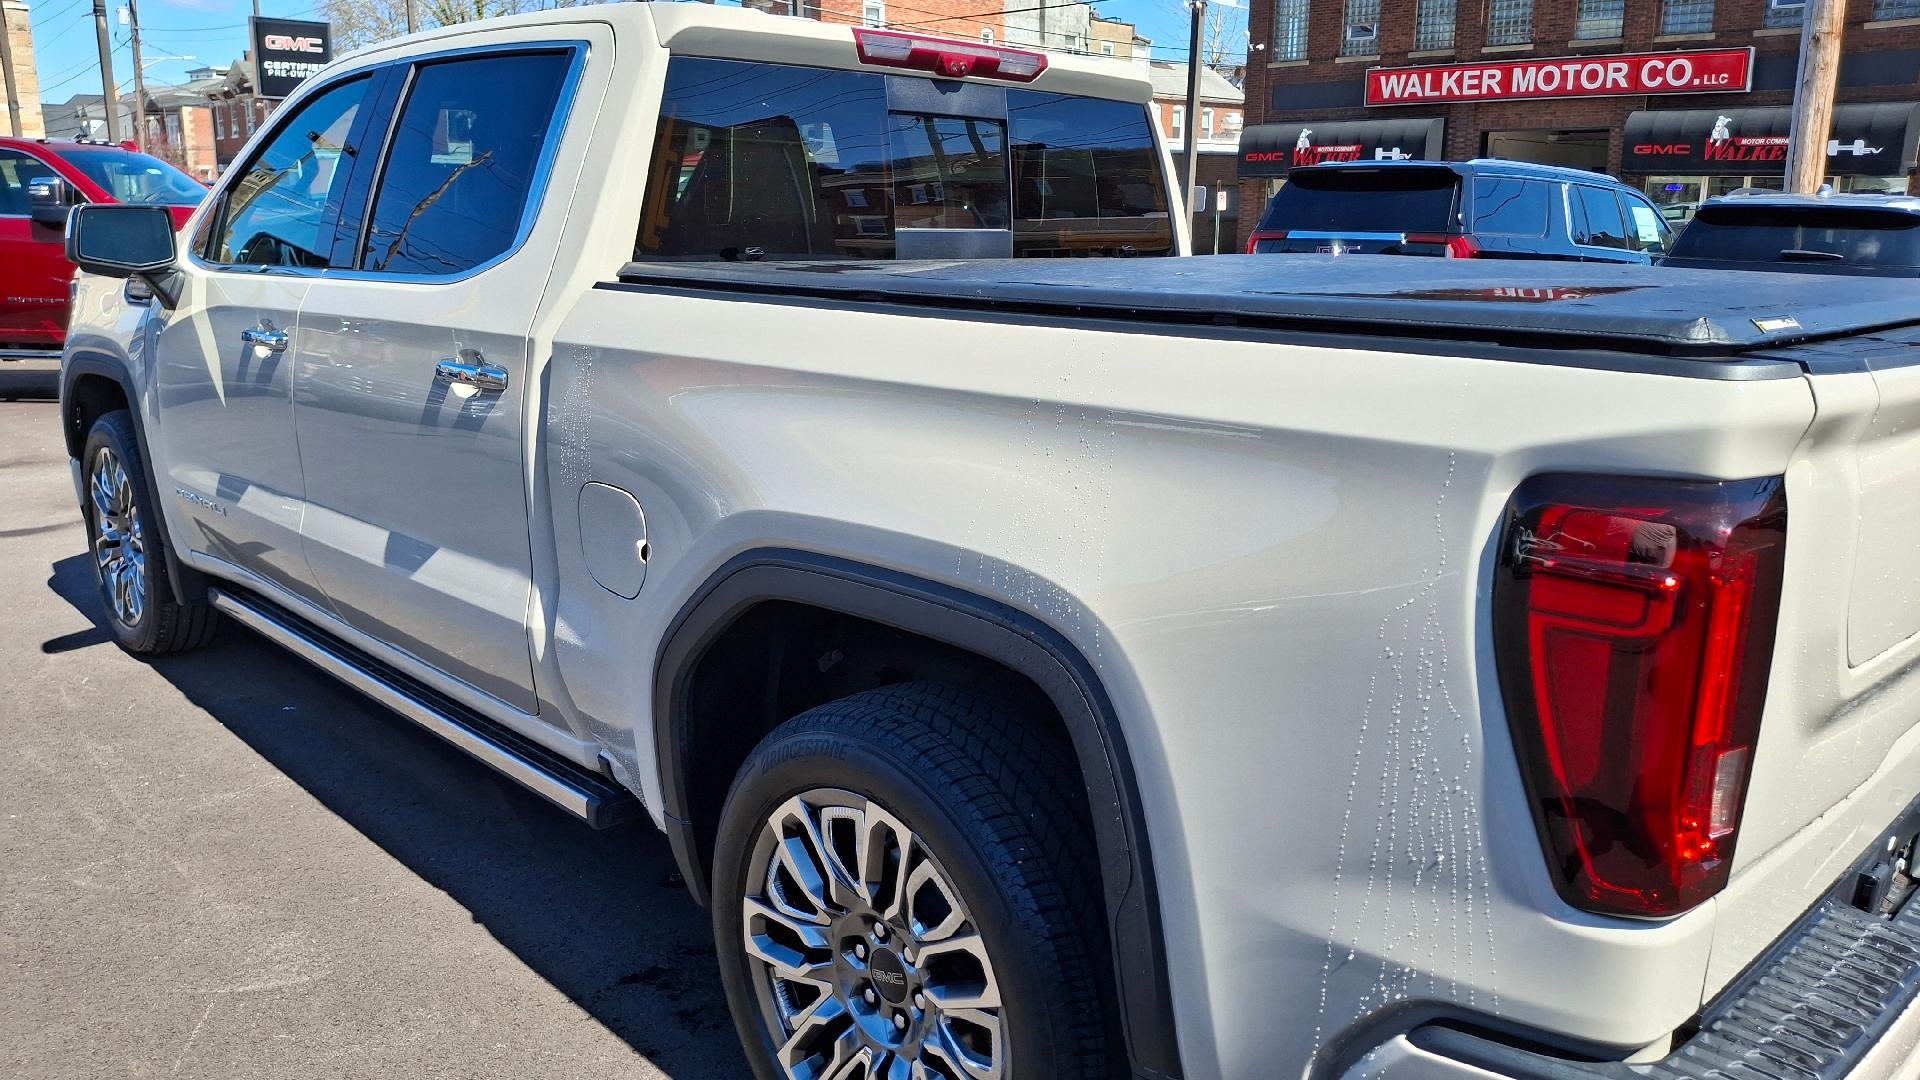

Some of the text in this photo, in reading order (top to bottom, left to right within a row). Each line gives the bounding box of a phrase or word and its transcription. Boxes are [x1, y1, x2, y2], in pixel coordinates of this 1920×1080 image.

[265, 35, 323, 53] GMC
[268, 69, 316, 78] PRE-OWN
[1380, 58, 1728, 98] WALKER MOTOR CO. LLC
[1245, 152, 1284, 161] GMC
[1293, 146, 1361, 166] WALKER
[1633, 144, 1691, 155] GMC
[1704, 137, 1788, 161] WALKE
[871, 968, 904, 985] GMC
